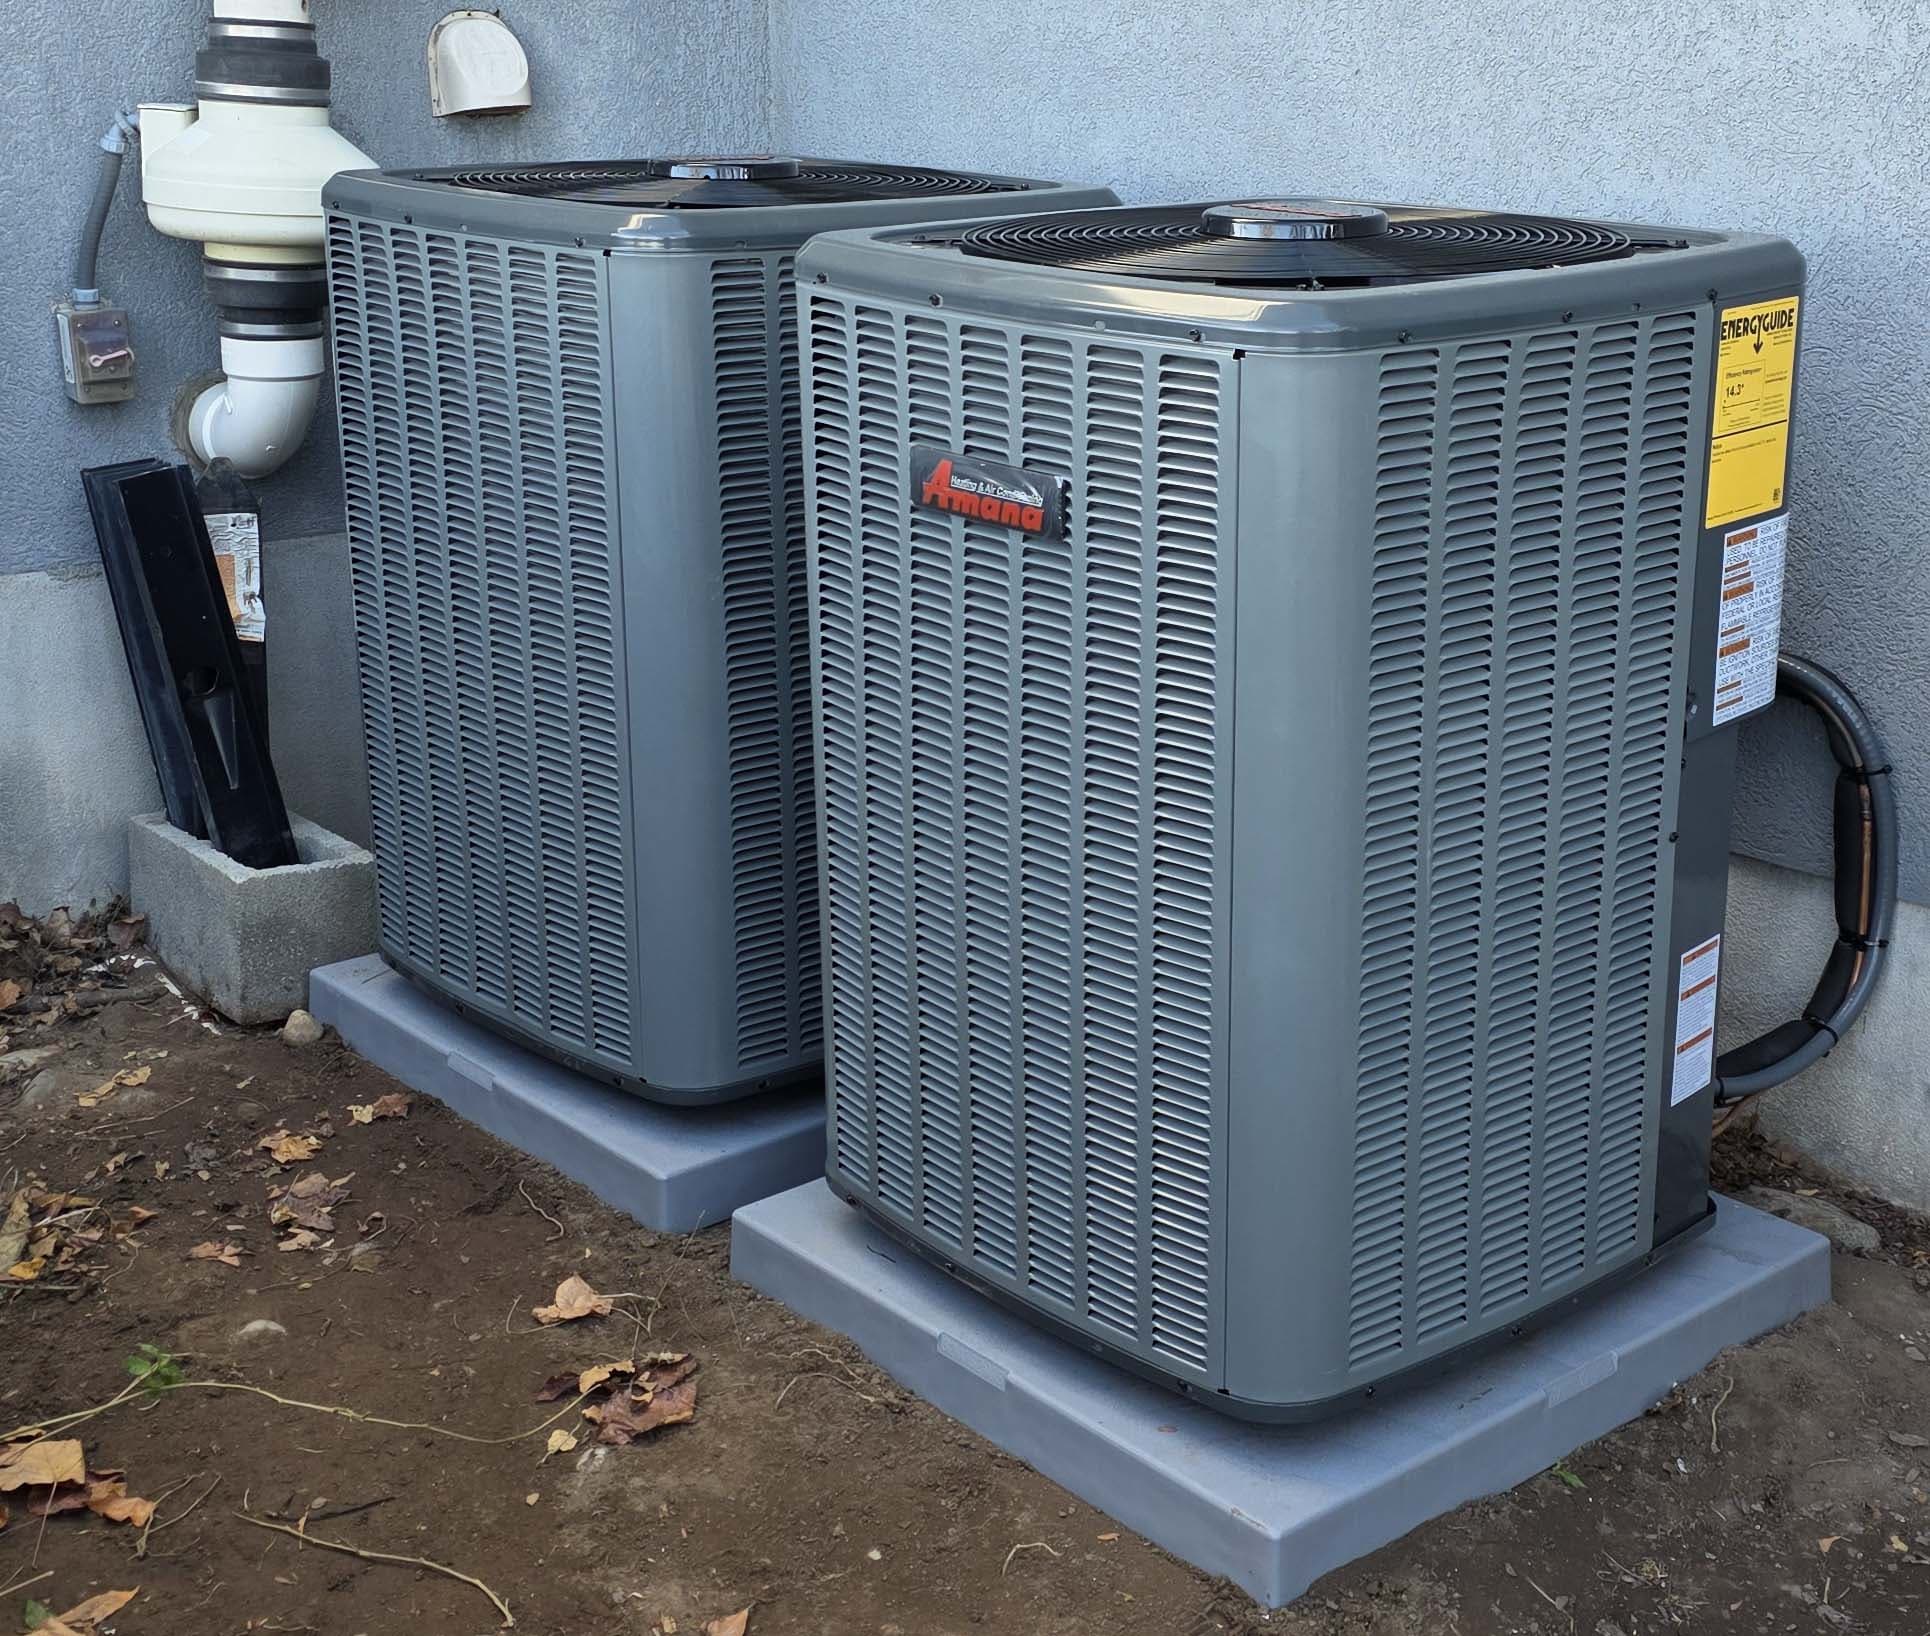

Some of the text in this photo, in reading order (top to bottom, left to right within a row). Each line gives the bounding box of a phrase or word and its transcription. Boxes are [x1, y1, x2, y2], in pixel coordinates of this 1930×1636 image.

[1721, 308, 1795, 341] ENERGYGUIDE
[923, 459, 1044, 532] Amana
[951, 475, 977, 491] Heating
[977, 482, 985, 493] &
[985, 483, 997, 494] Air
